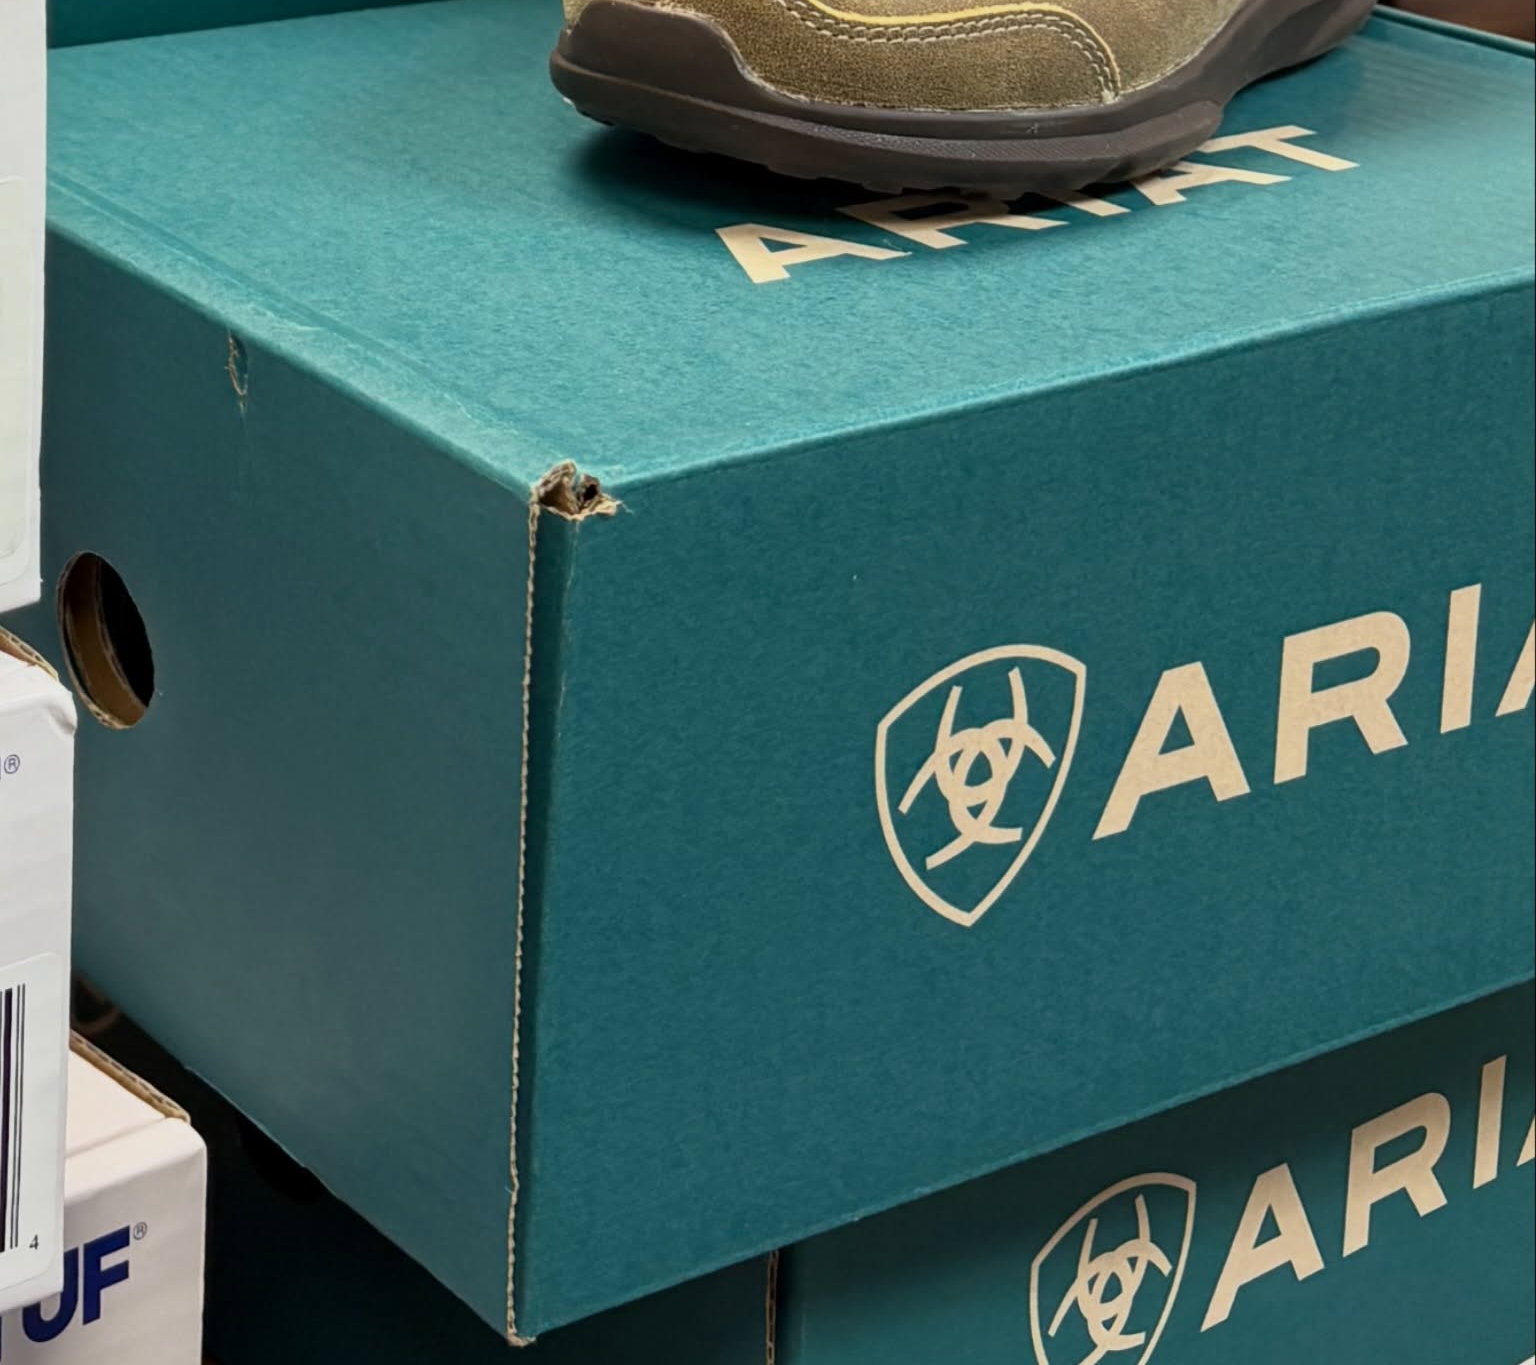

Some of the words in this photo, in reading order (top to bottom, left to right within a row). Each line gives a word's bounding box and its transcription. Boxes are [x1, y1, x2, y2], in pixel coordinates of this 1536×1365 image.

[1093, 583, 1535, 840] ARI
[29, 1234, 40, 1251] 4
[1200, 1055, 1535, 1332] ARI
